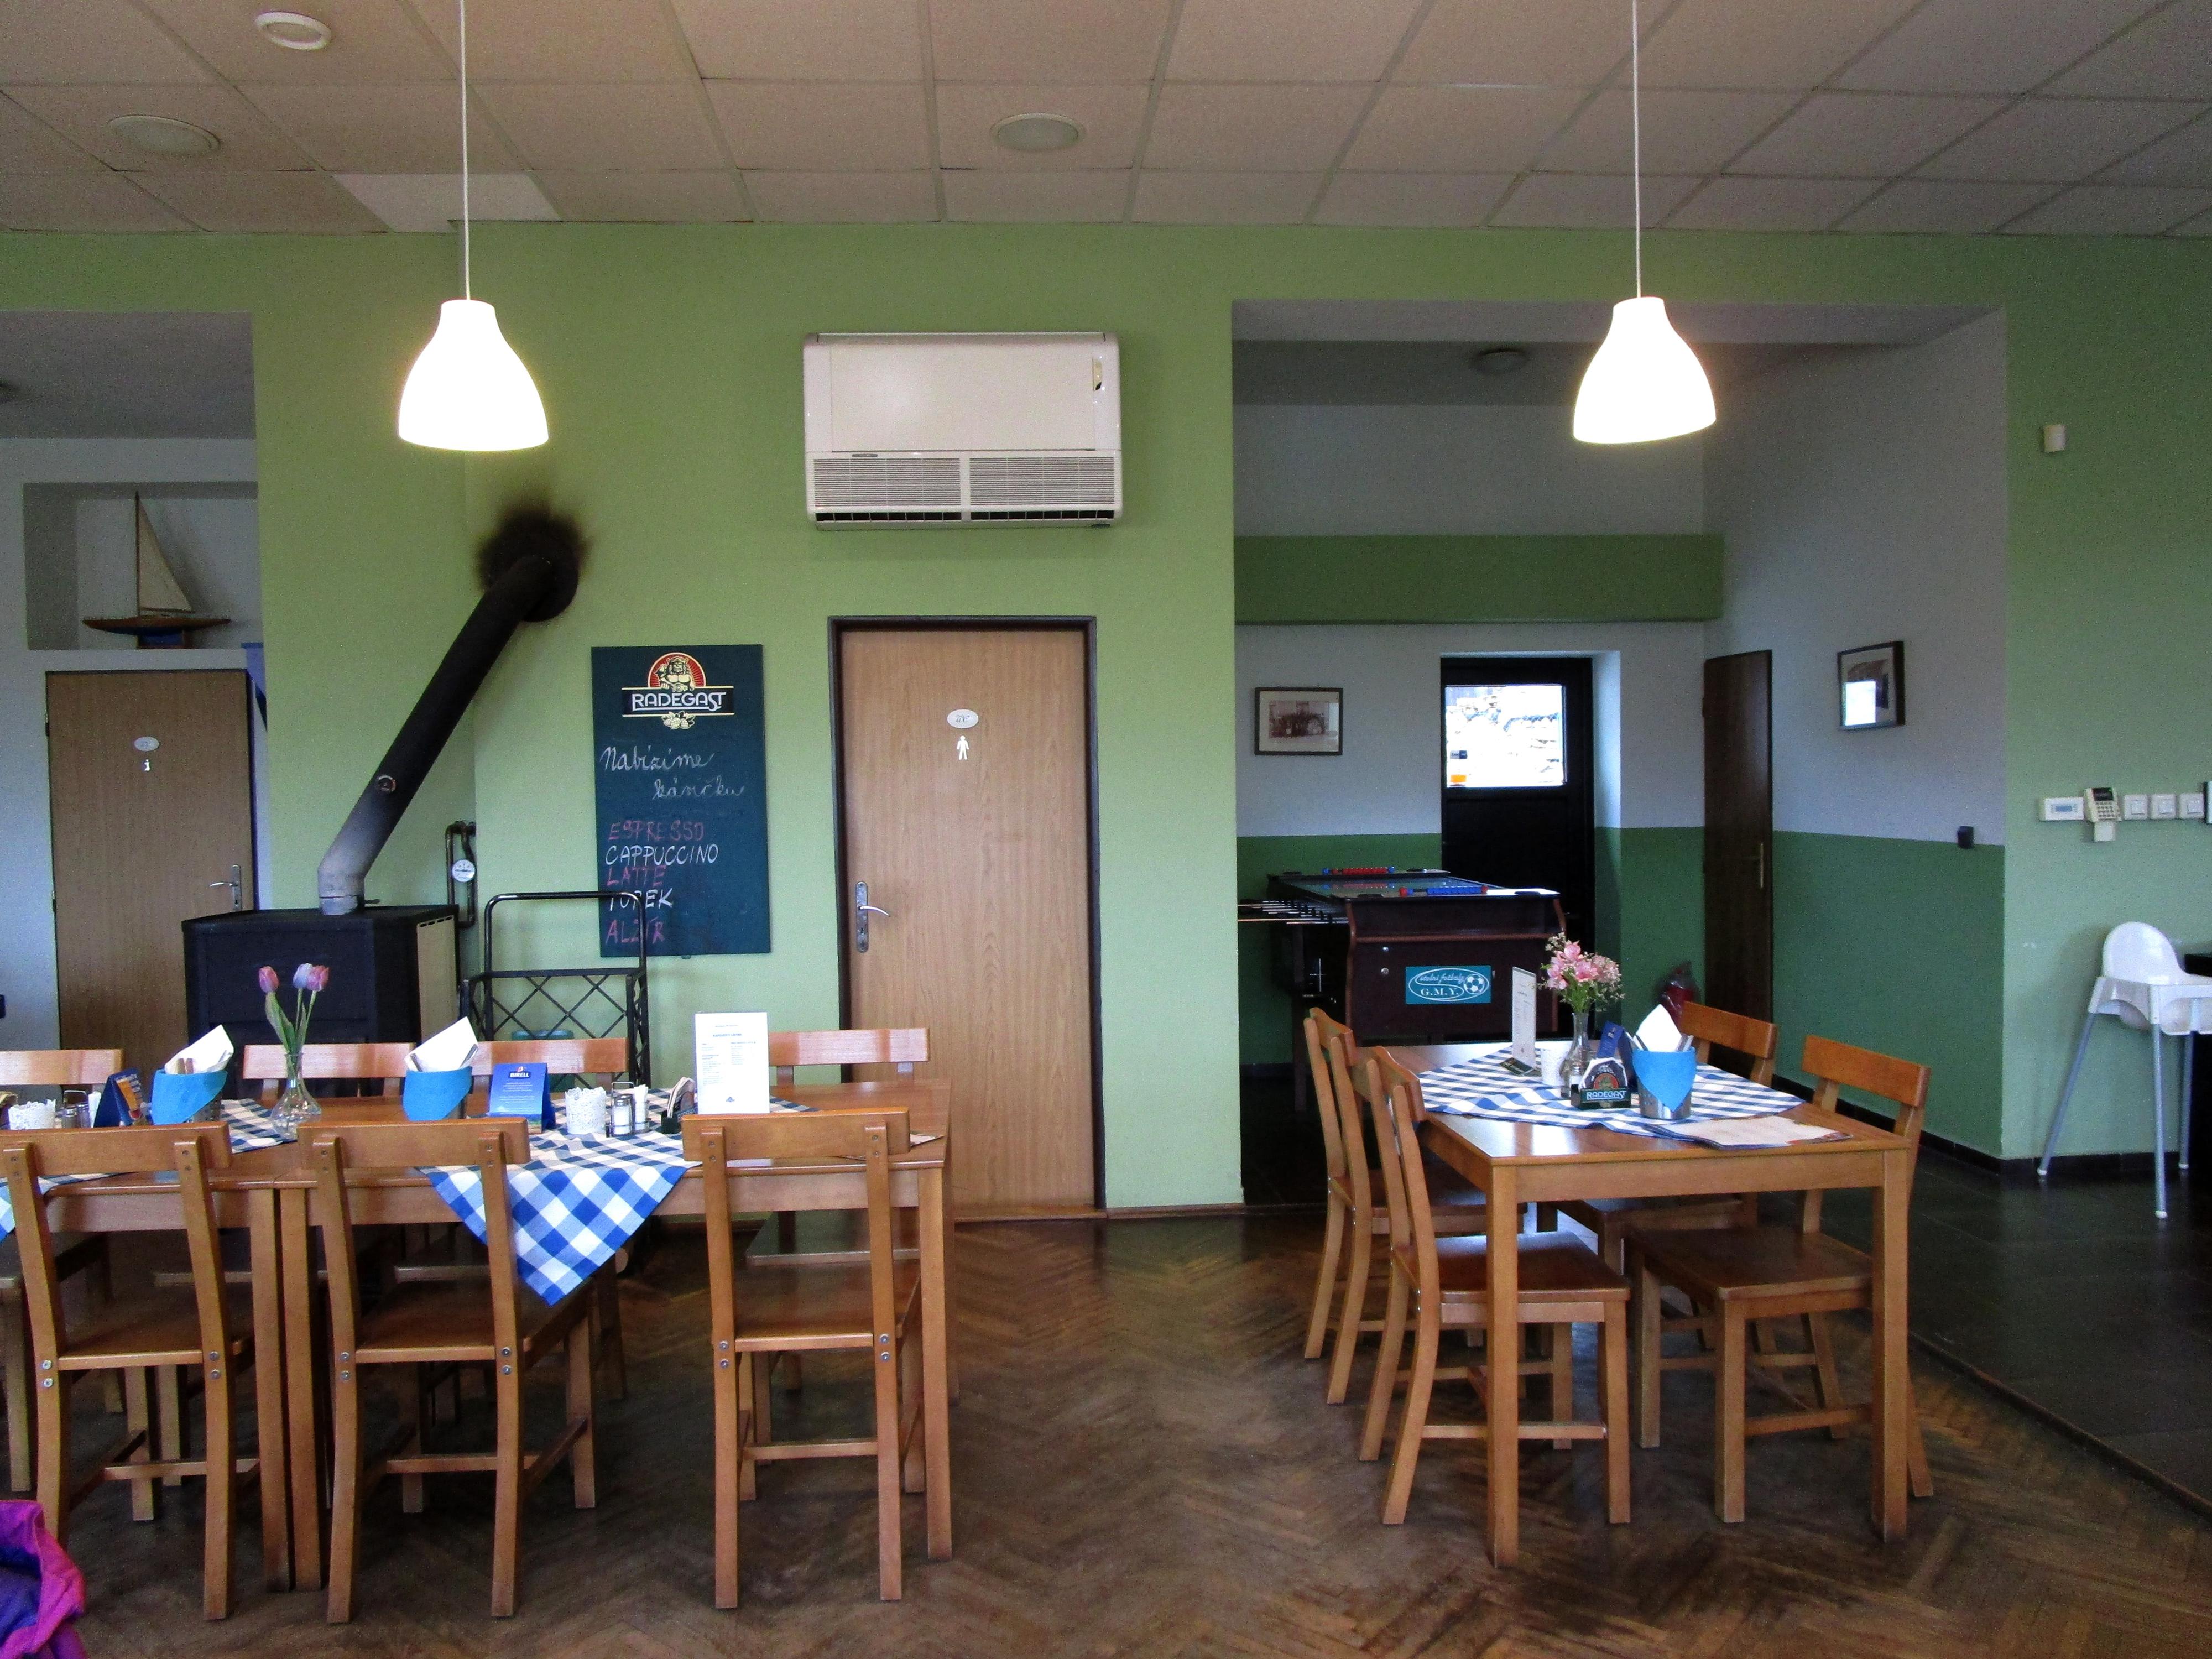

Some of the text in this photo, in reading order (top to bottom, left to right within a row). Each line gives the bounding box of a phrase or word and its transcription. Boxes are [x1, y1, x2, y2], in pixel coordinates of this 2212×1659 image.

[632, 692, 727, 712] RADEGAST
[609, 820, 704, 841] ESPRESSO
[606, 843, 718, 867] CAPPUCCINO
[607, 865, 667, 888] LATTE
[1587, 1090, 1627, 1100] RADEGAST
